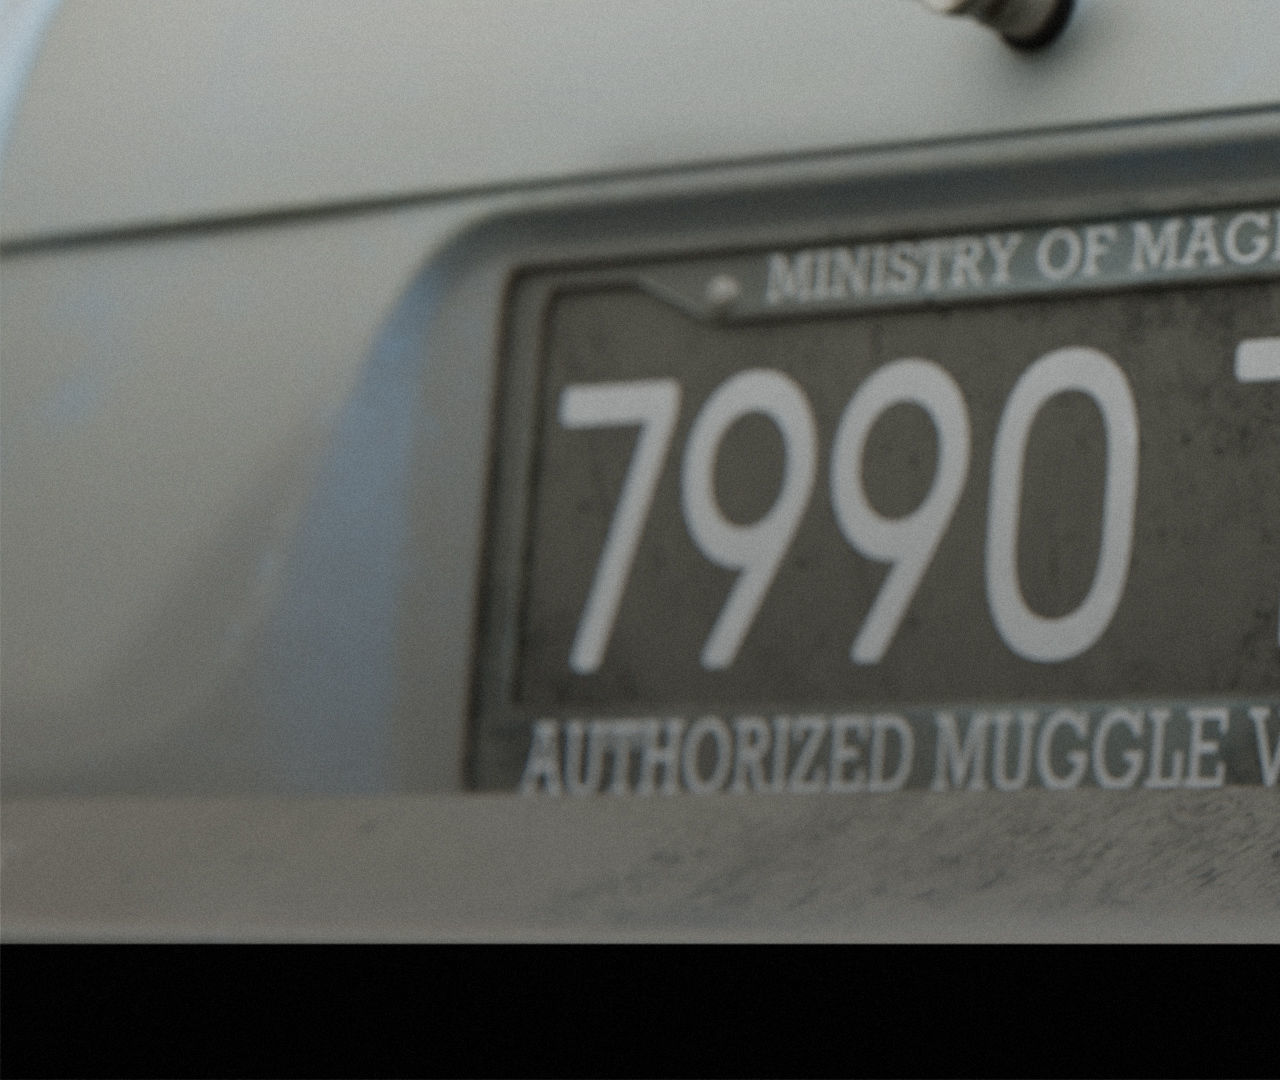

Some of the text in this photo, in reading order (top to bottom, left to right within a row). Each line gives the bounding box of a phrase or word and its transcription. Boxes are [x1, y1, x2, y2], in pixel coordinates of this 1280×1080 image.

[764, 232, 1023, 306] MINISTRY
[1034, 223, 1117, 281] OF
[559, 344, 1141, 676] 7990
[519, 713, 916, 797] AUTHORIZED
[931, 705, 1230, 791] MUGGLE
